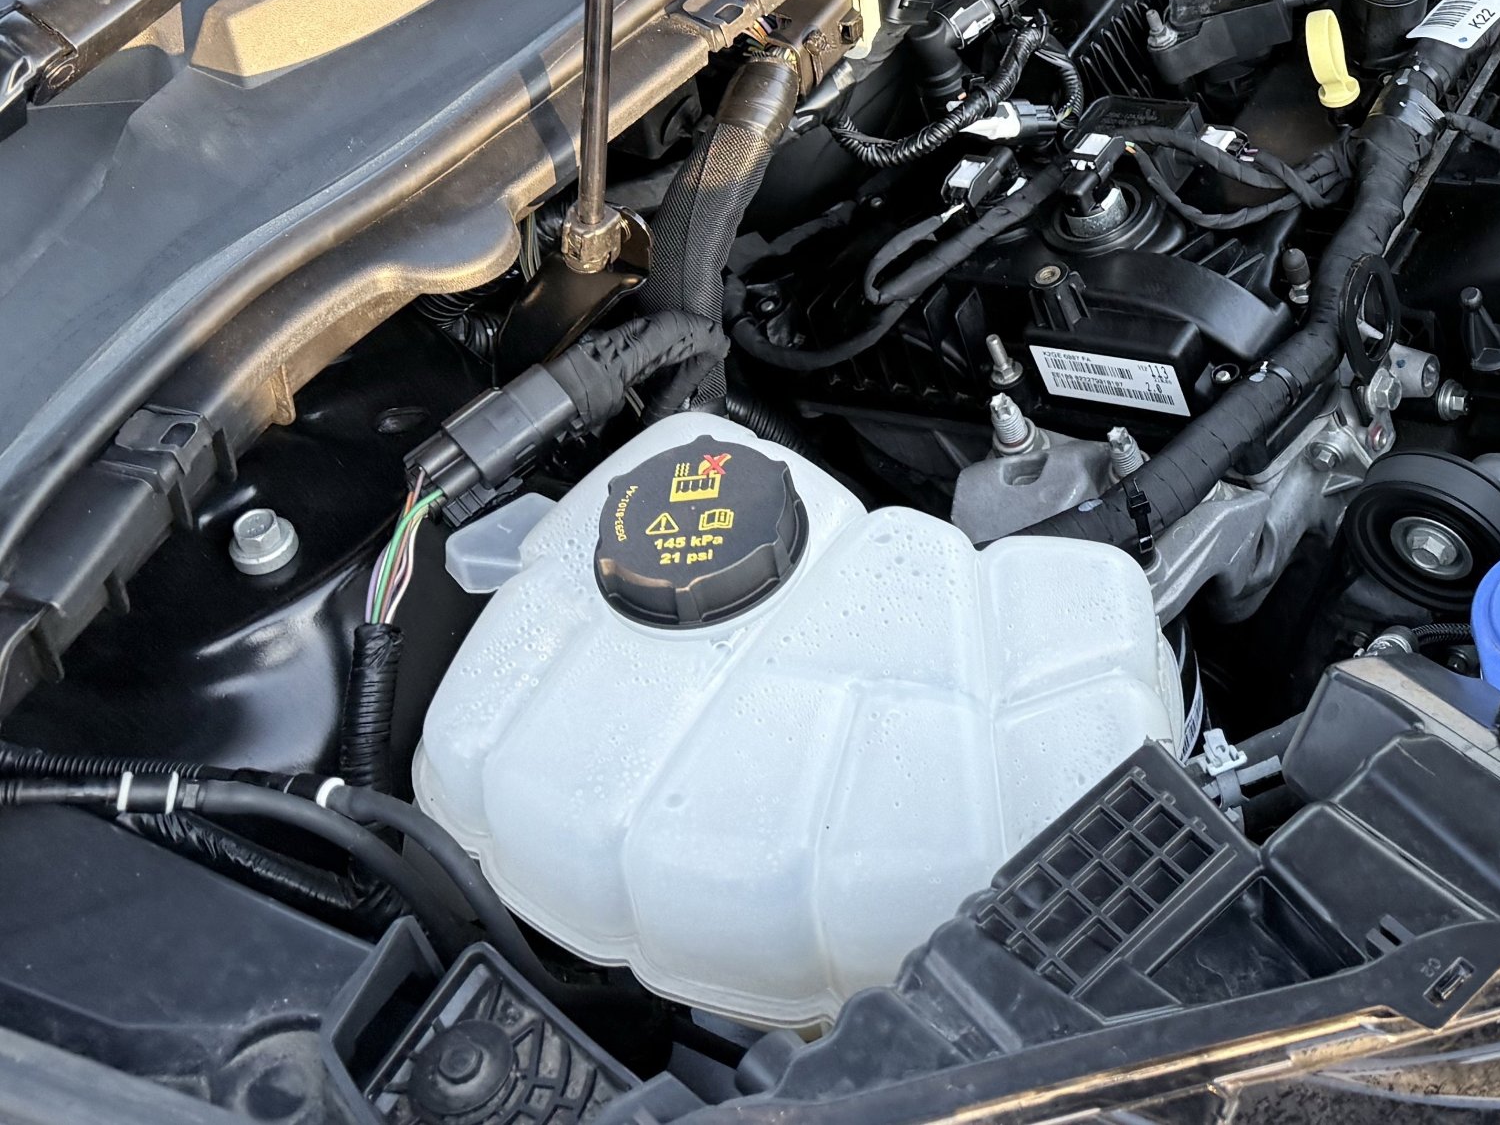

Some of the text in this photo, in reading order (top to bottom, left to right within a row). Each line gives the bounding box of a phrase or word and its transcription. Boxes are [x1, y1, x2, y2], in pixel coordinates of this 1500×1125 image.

[1468, 8, 1496, 29] K22
[1148, 364, 1169, 379] 113
[1145, 382, 1163, 394] 2.0
[654, 534, 723, 550] 145 kPa
[659, 549, 714, 565] 21 psi
